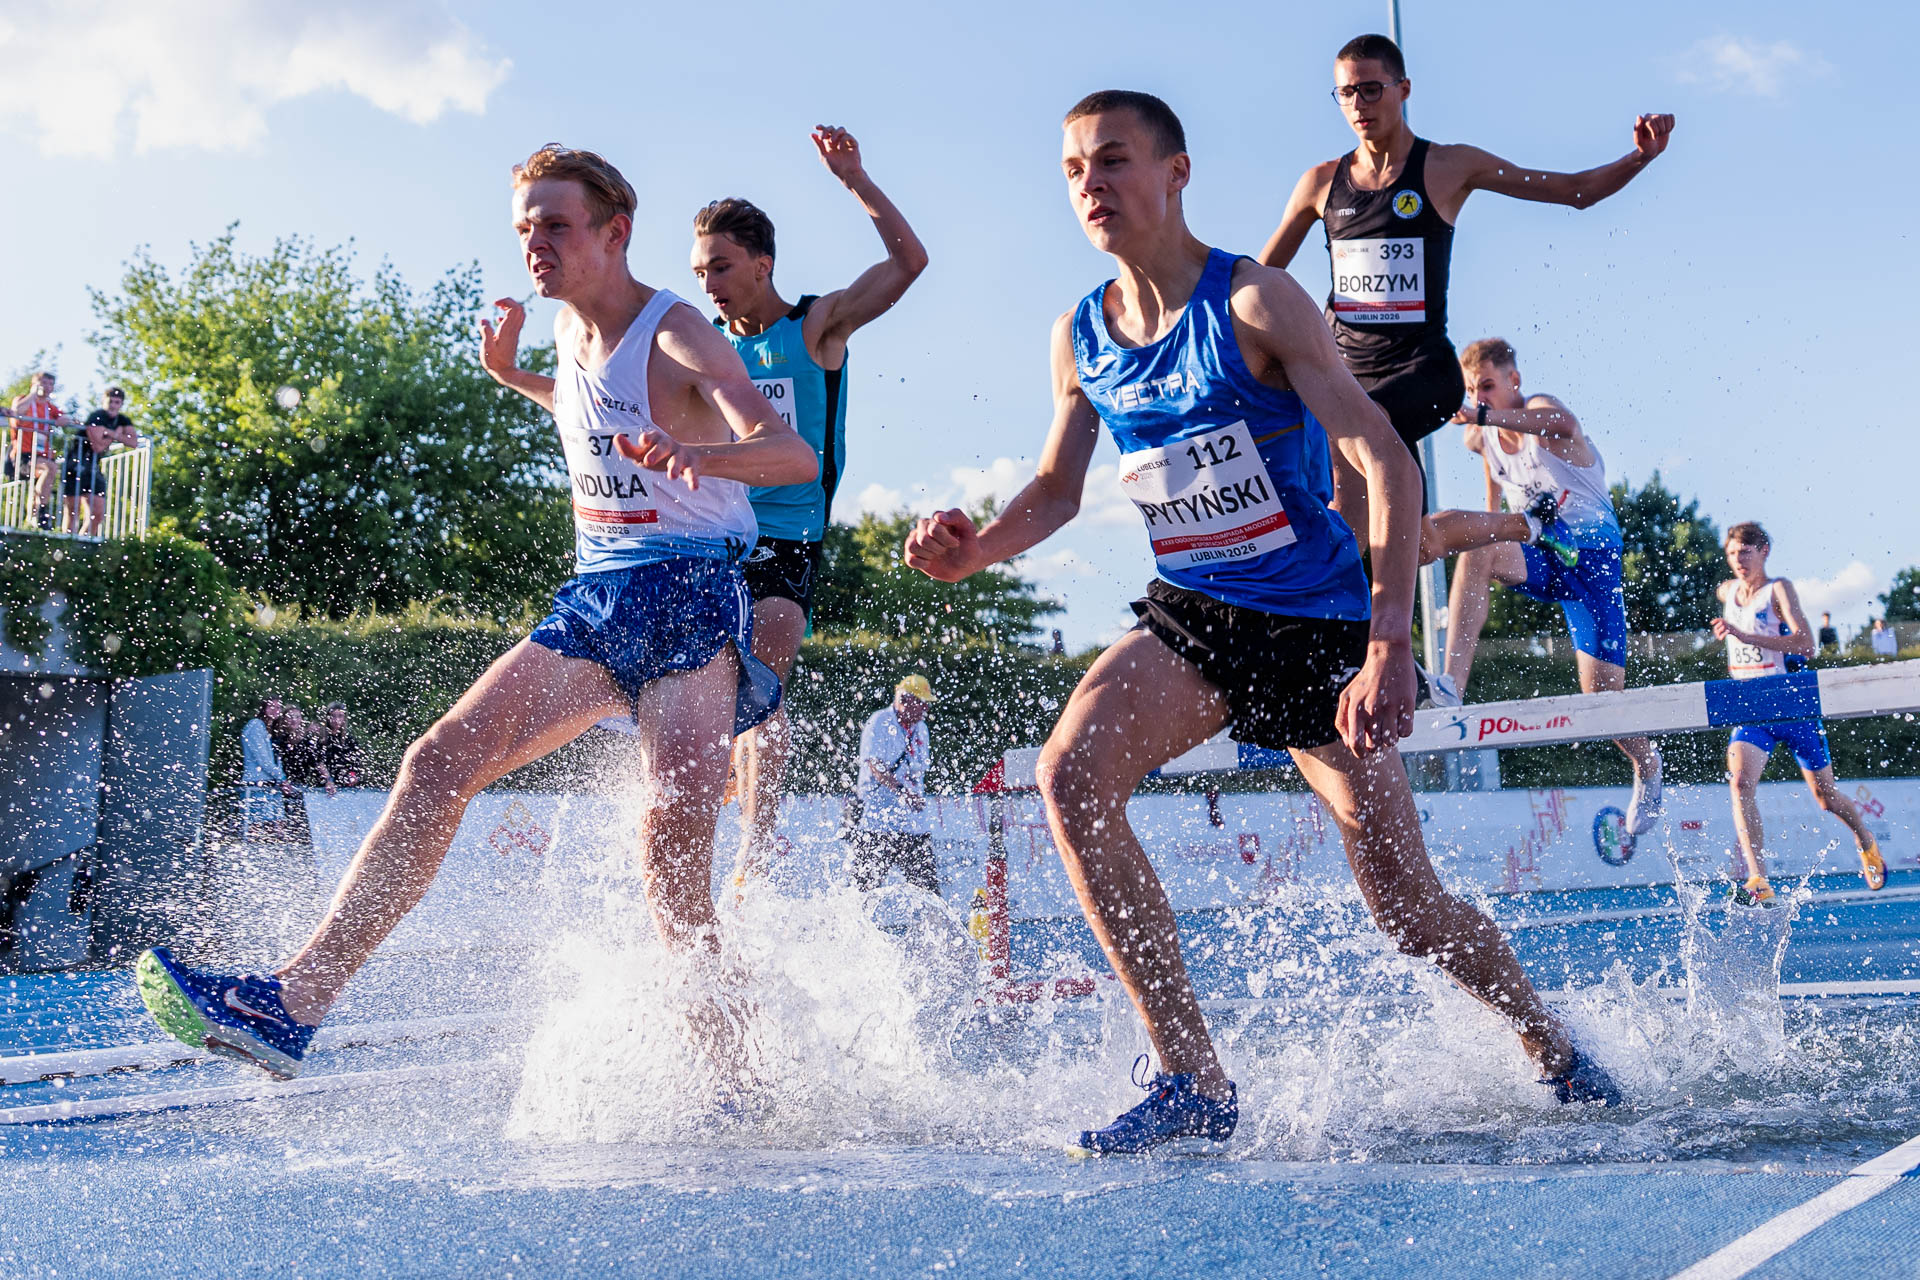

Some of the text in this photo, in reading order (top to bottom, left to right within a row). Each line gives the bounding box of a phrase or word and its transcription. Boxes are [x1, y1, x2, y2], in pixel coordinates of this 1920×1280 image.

[1380, 243, 1414, 260] 393
[1339, 273, 1418, 293] BORZYM
[1354, 312, 1400, 321] LUBLIN 2026
[756, 383, 785, 400] 00
[1107, 369, 1201, 411] VECTRA
[588, 433, 629, 456] 37
[1186, 434, 1242, 471] 112
[1136, 457, 1172, 472] LUBELSKIE
[1139, 475, 1270, 526] PYTYŃSKI
[607, 525, 630, 535] 2026
[1189, 542, 1257, 563] LUBLIN 2026
[1734, 646, 1764, 664] 853
